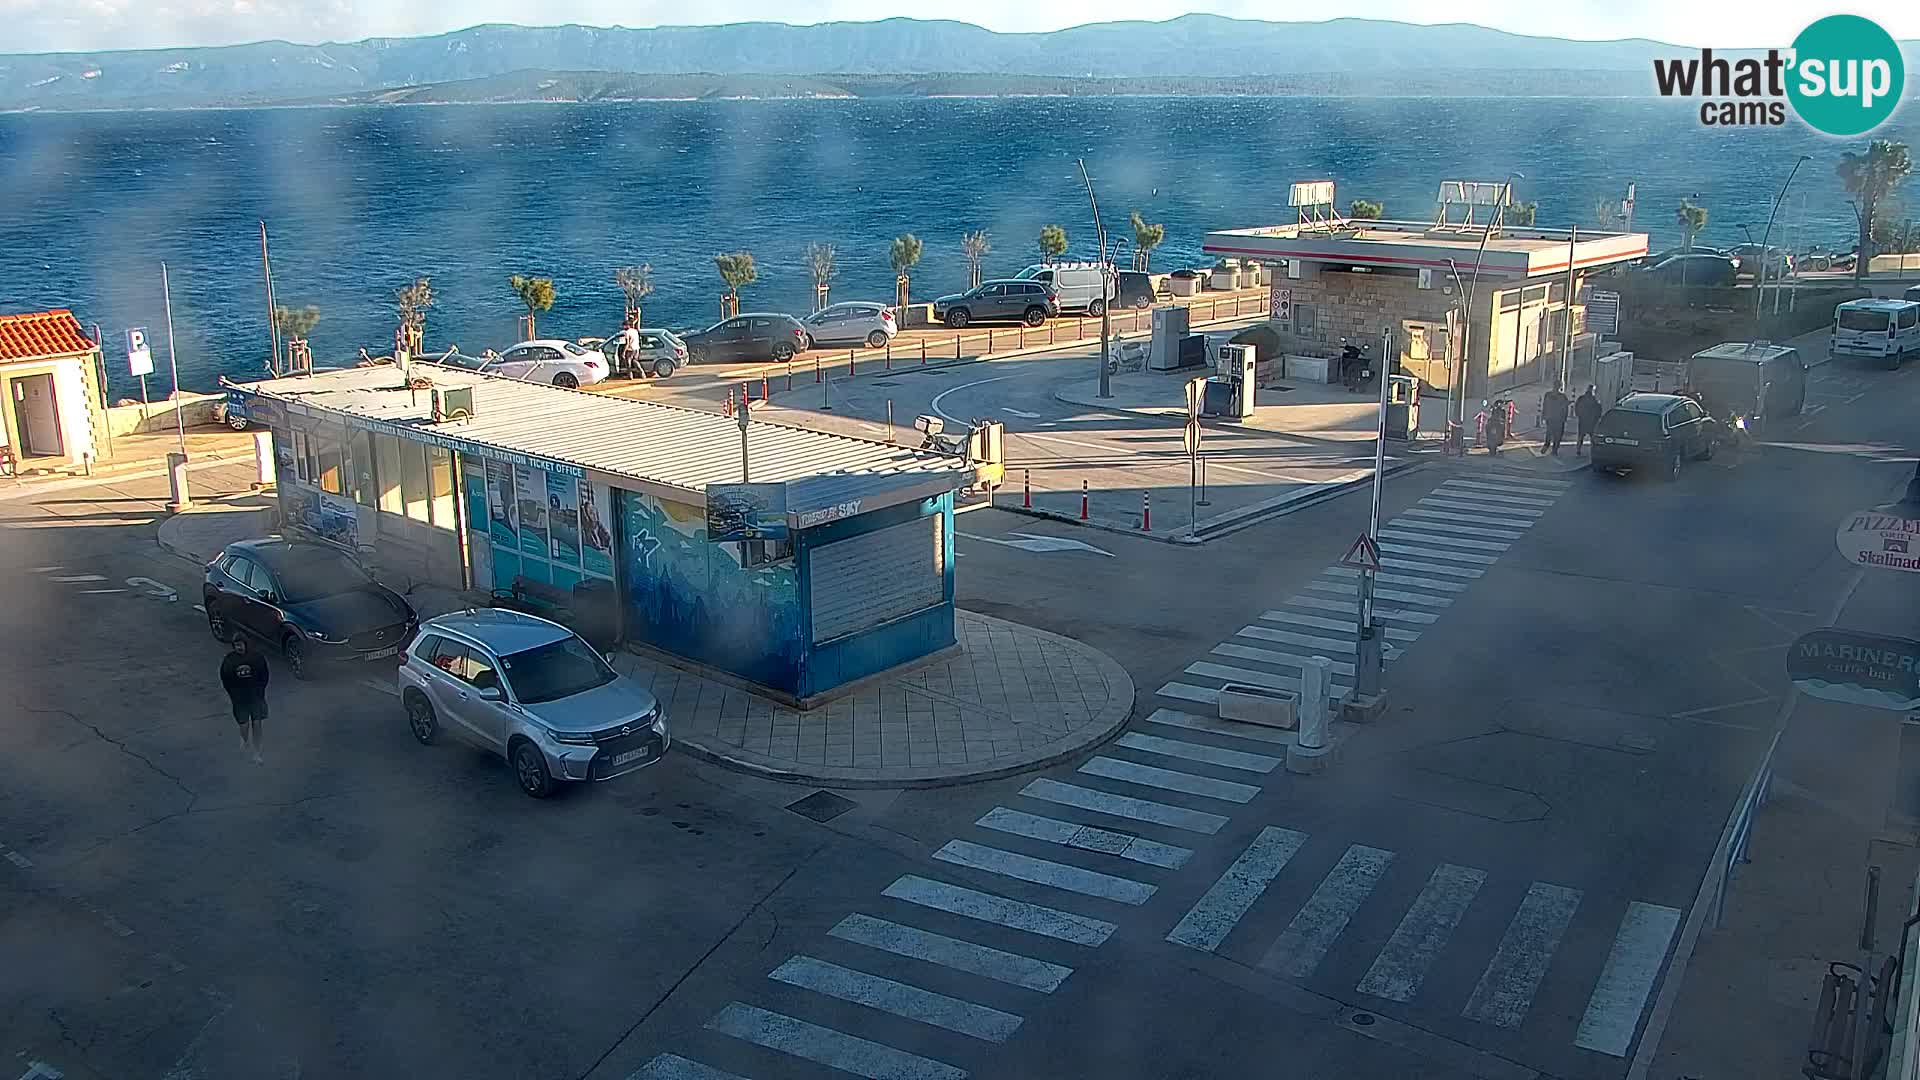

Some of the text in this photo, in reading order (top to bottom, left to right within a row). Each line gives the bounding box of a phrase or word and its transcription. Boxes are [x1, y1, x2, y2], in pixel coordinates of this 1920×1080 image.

[131, 331, 145, 352] P
[396, 428, 437, 445] AUTOBUSNA
[437, 438, 469, 453] POSTAJA
[479, 447, 493, 458] BUS
[495, 450, 526, 465] STATION
[529, 458, 555, 470] TICKET
[556, 462, 583, 477] OFFICE
